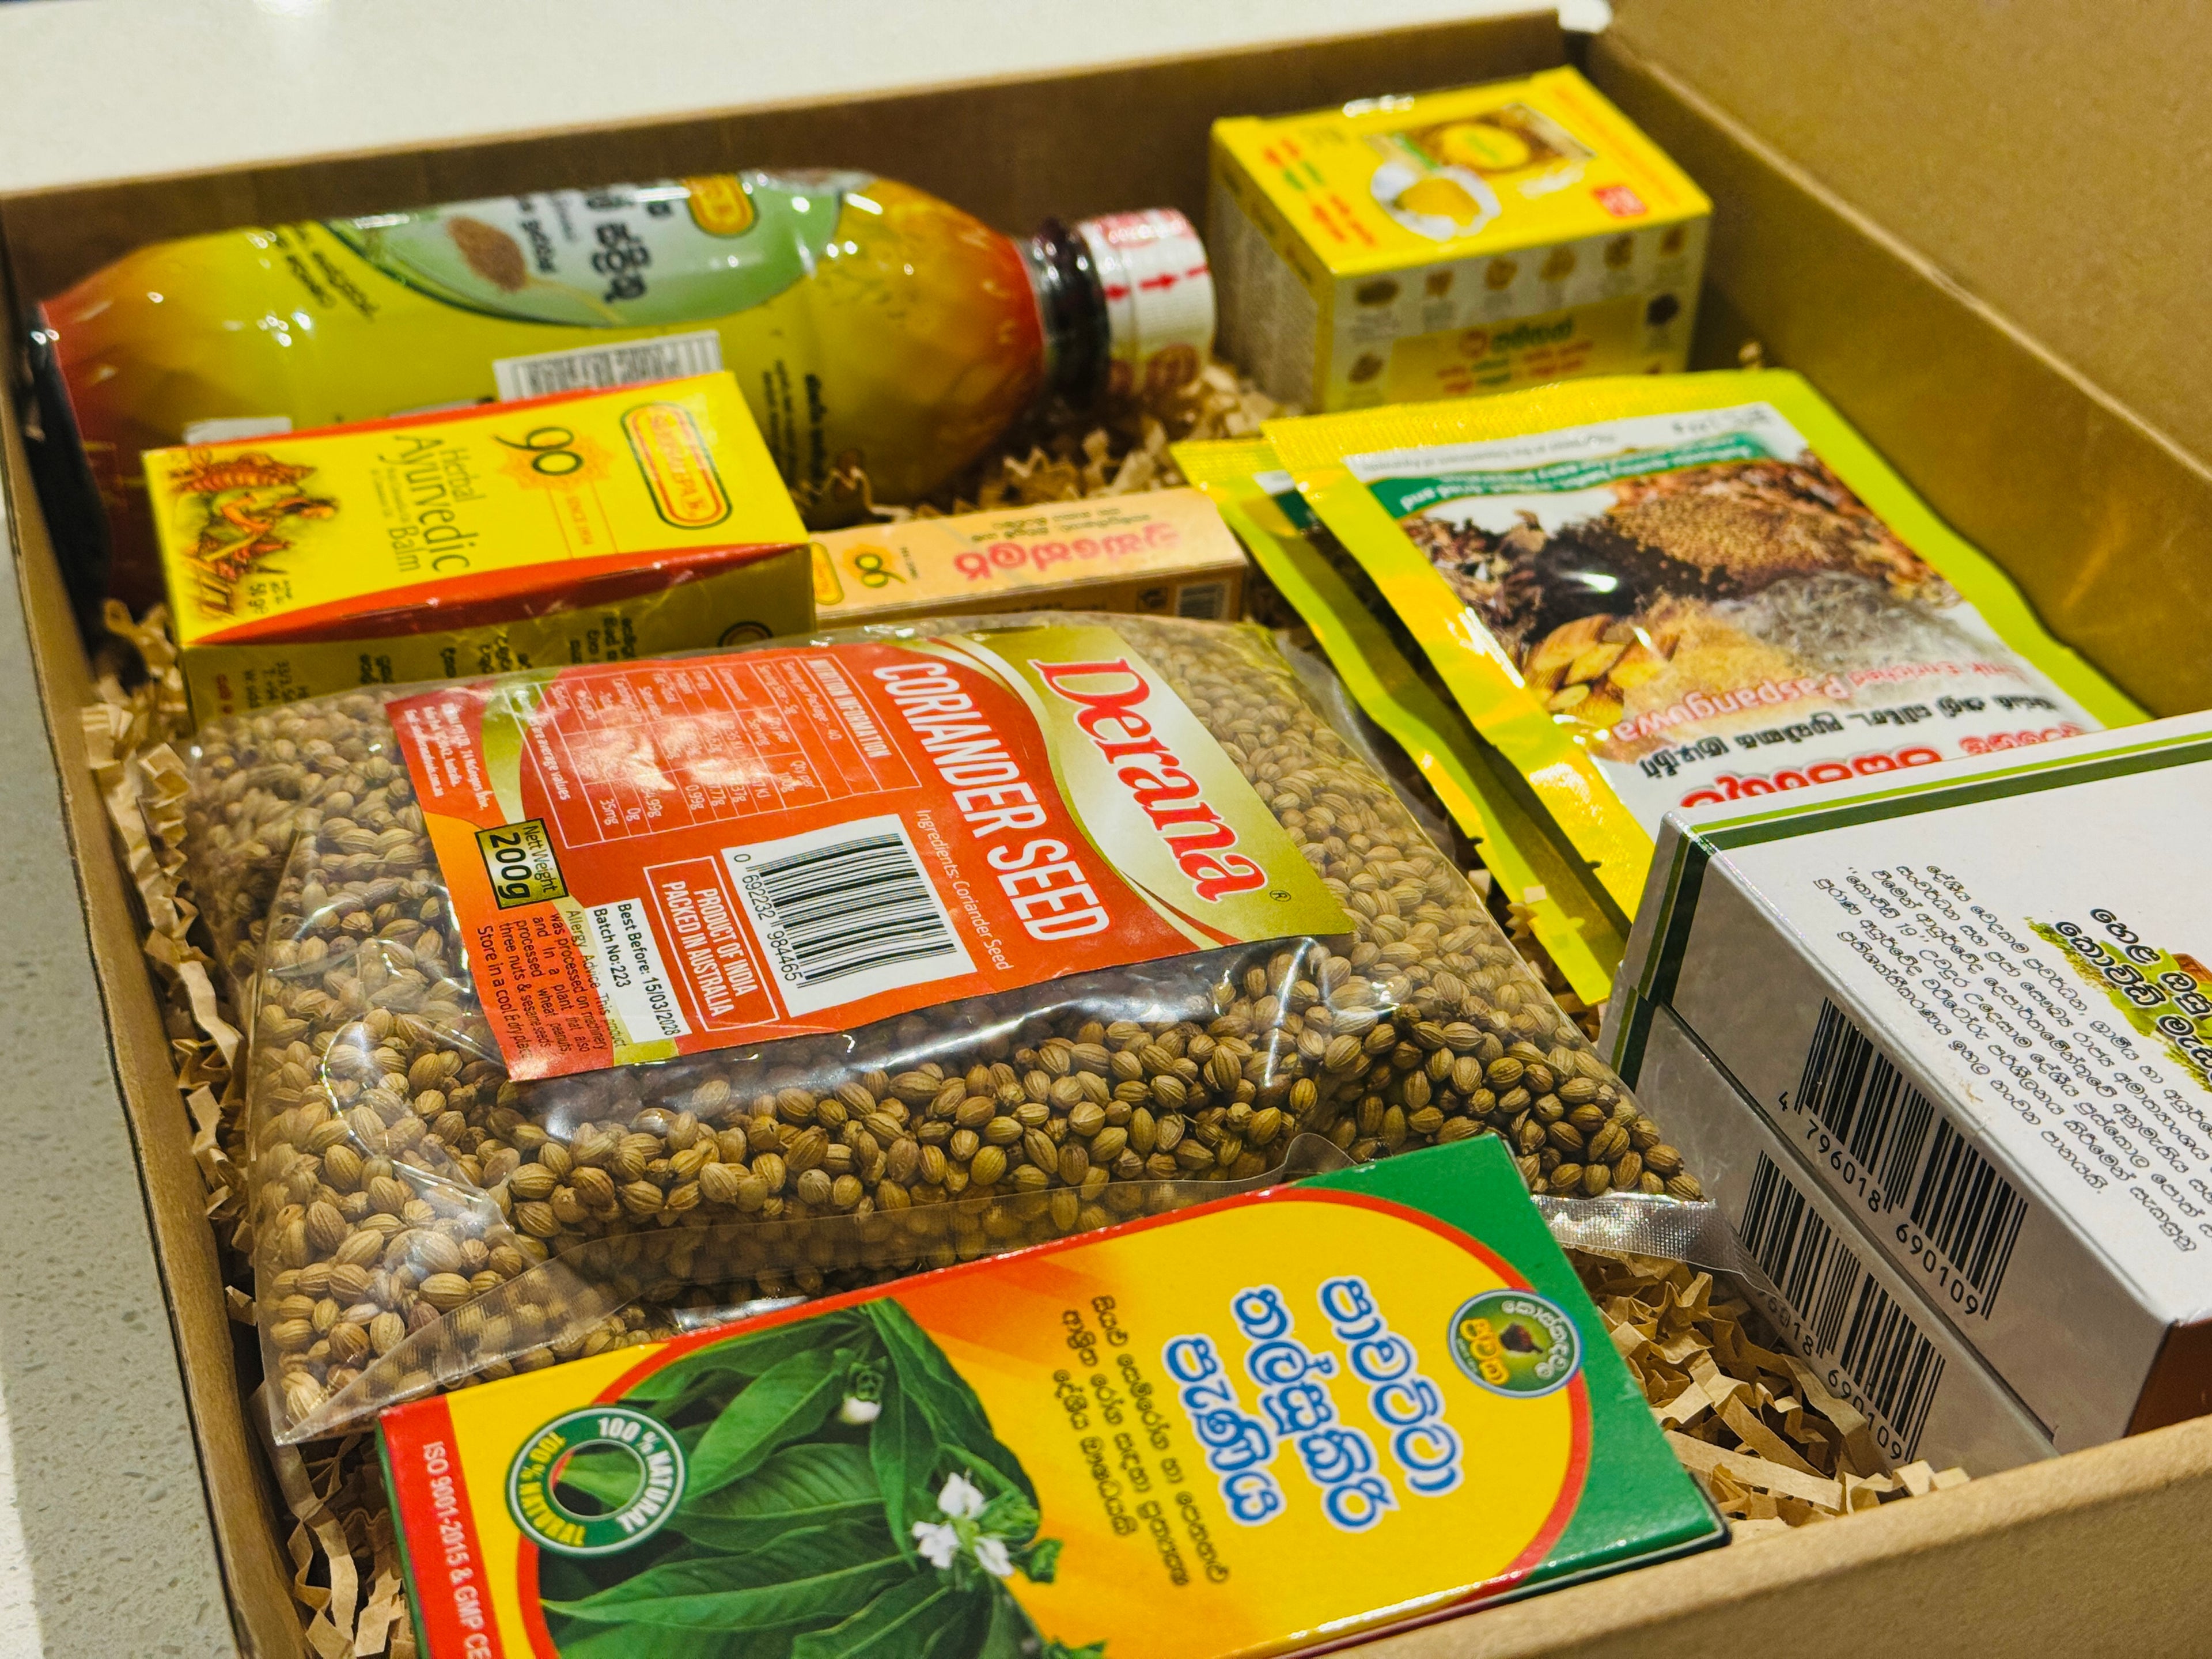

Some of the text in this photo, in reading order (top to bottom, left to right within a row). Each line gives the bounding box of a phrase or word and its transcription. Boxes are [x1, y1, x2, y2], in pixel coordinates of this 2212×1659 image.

[441, 447, 485, 503] Herbal
[493, 426, 584, 476] 90
[378, 435, 482, 571] Ayurvedic
[388, 526, 421, 573] Balm
[803, 693, 832, 722] Package
[825, 728, 842, 740] 40
[806, 658, 852, 696] NUTRITION
[834, 696, 891, 758] INFORMATION
[1608, 665, 1857, 744] Paspanguwa
[531, 726, 546, 738] are
[532, 738, 560, 771] average
[550, 771, 573, 800] values
[790, 759, 810, 775] Qty
[1031, 658, 1267, 903] Derana
[599, 798, 622, 825] 35mg
[625, 807, 643, 821] 0g
[684, 783, 707, 810] 0.99g
[876, 664, 1108, 940] CORIANDER SEED
[487, 831, 537, 902] 200g
[520, 825, 559, 893] Nett Weight
[917, 810, 1013, 969] Ingredients: Coriander Seed
[476, 926, 498, 961] Store
[498, 923, 518, 952] three
[548, 913, 565, 937] was
[592, 908, 617, 943] Batch
[664, 881, 733, 1016] PACKED IN AUSTRALIA
[695, 889, 757, 995] PRODUCT OF INDIA
[740, 874, 778, 921] 692232
[766, 930, 804, 982] 984465
[487, 963, 504, 976] in
[491, 979, 505, 987] a
[507, 955, 527, 980] nuts
[513, 919, 544, 977] processed
[536, 988, 559, 1017] wheat
[516, 982, 530, 993] &
[532, 916, 552, 943] and
[551, 983, 574, 1010] plant
[573, 1035, 590, 1052] also
[554, 938, 586, 993] processed
[565, 910, 589, 948] Allergy
[579, 954, 604, 988] Advice
[593, 993, 613, 1016] This
[616, 903, 681, 1036] Best Before: 15/03/2028
[494, 989, 516, 1014] cool
[575, 995, 589, 1009] on
[1778, 1090, 1980, 1317] 4 796018 690109
[598, 1416, 642, 1441] 100
[518, 1482, 587, 1548] NATURAL
[615, 1450, 673, 1533] NATURAL
[422, 1441, 448, 1475] ISO
[453, 1586, 483, 1630] GMP
